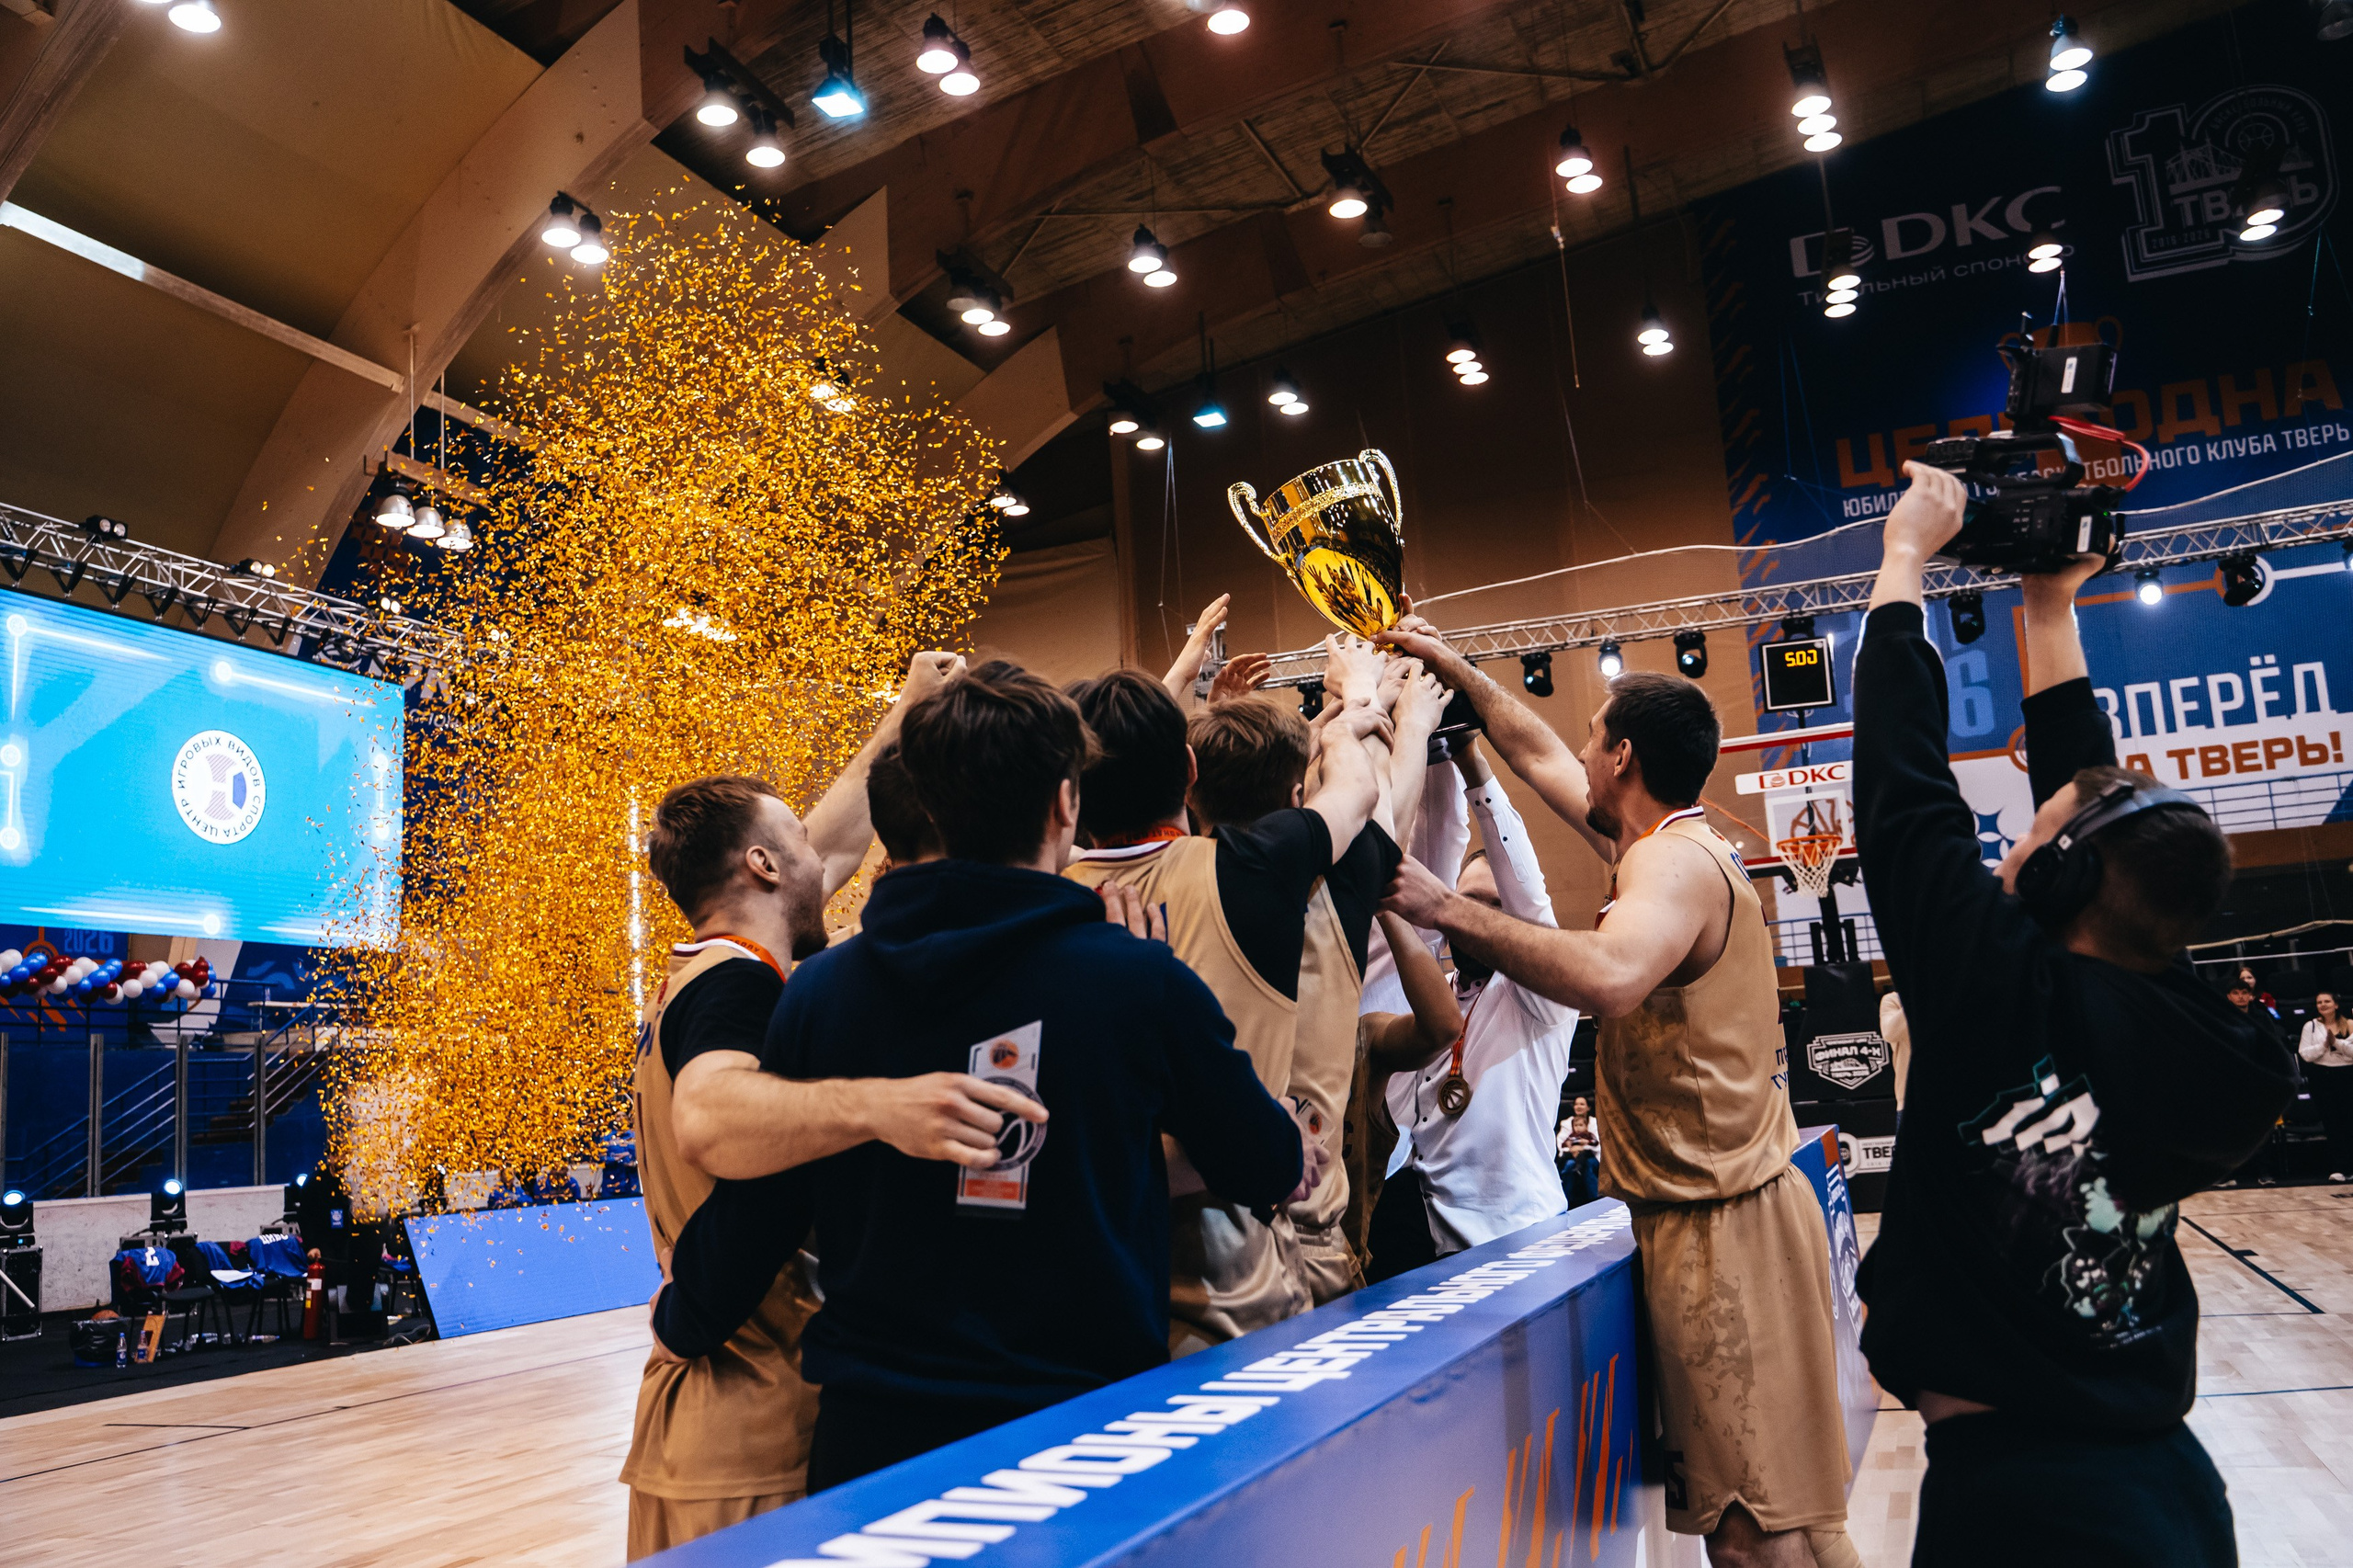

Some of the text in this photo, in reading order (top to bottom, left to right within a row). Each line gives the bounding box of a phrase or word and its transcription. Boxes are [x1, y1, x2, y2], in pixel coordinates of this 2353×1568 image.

[1881, 186, 2065, 260] DKC
[2172, 175, 2319, 226] ТВЬ
[2206, 434, 2277, 464] КЛУБА
[2281, 421, 2350, 450] ТВЕРЬ
[1788, 765, 1846, 786] DKC
[2166, 731, 2344, 780] ТВЕРЬ!
[177, 736, 261, 837] ЦЕНТР ИГРОВЫХ ВИДОВ СПОРТА
[1862, 1145, 1894, 1160] ТВЕ
[1199, 1259, 1557, 1392] ЦЕНТРАЛЬНОГО
